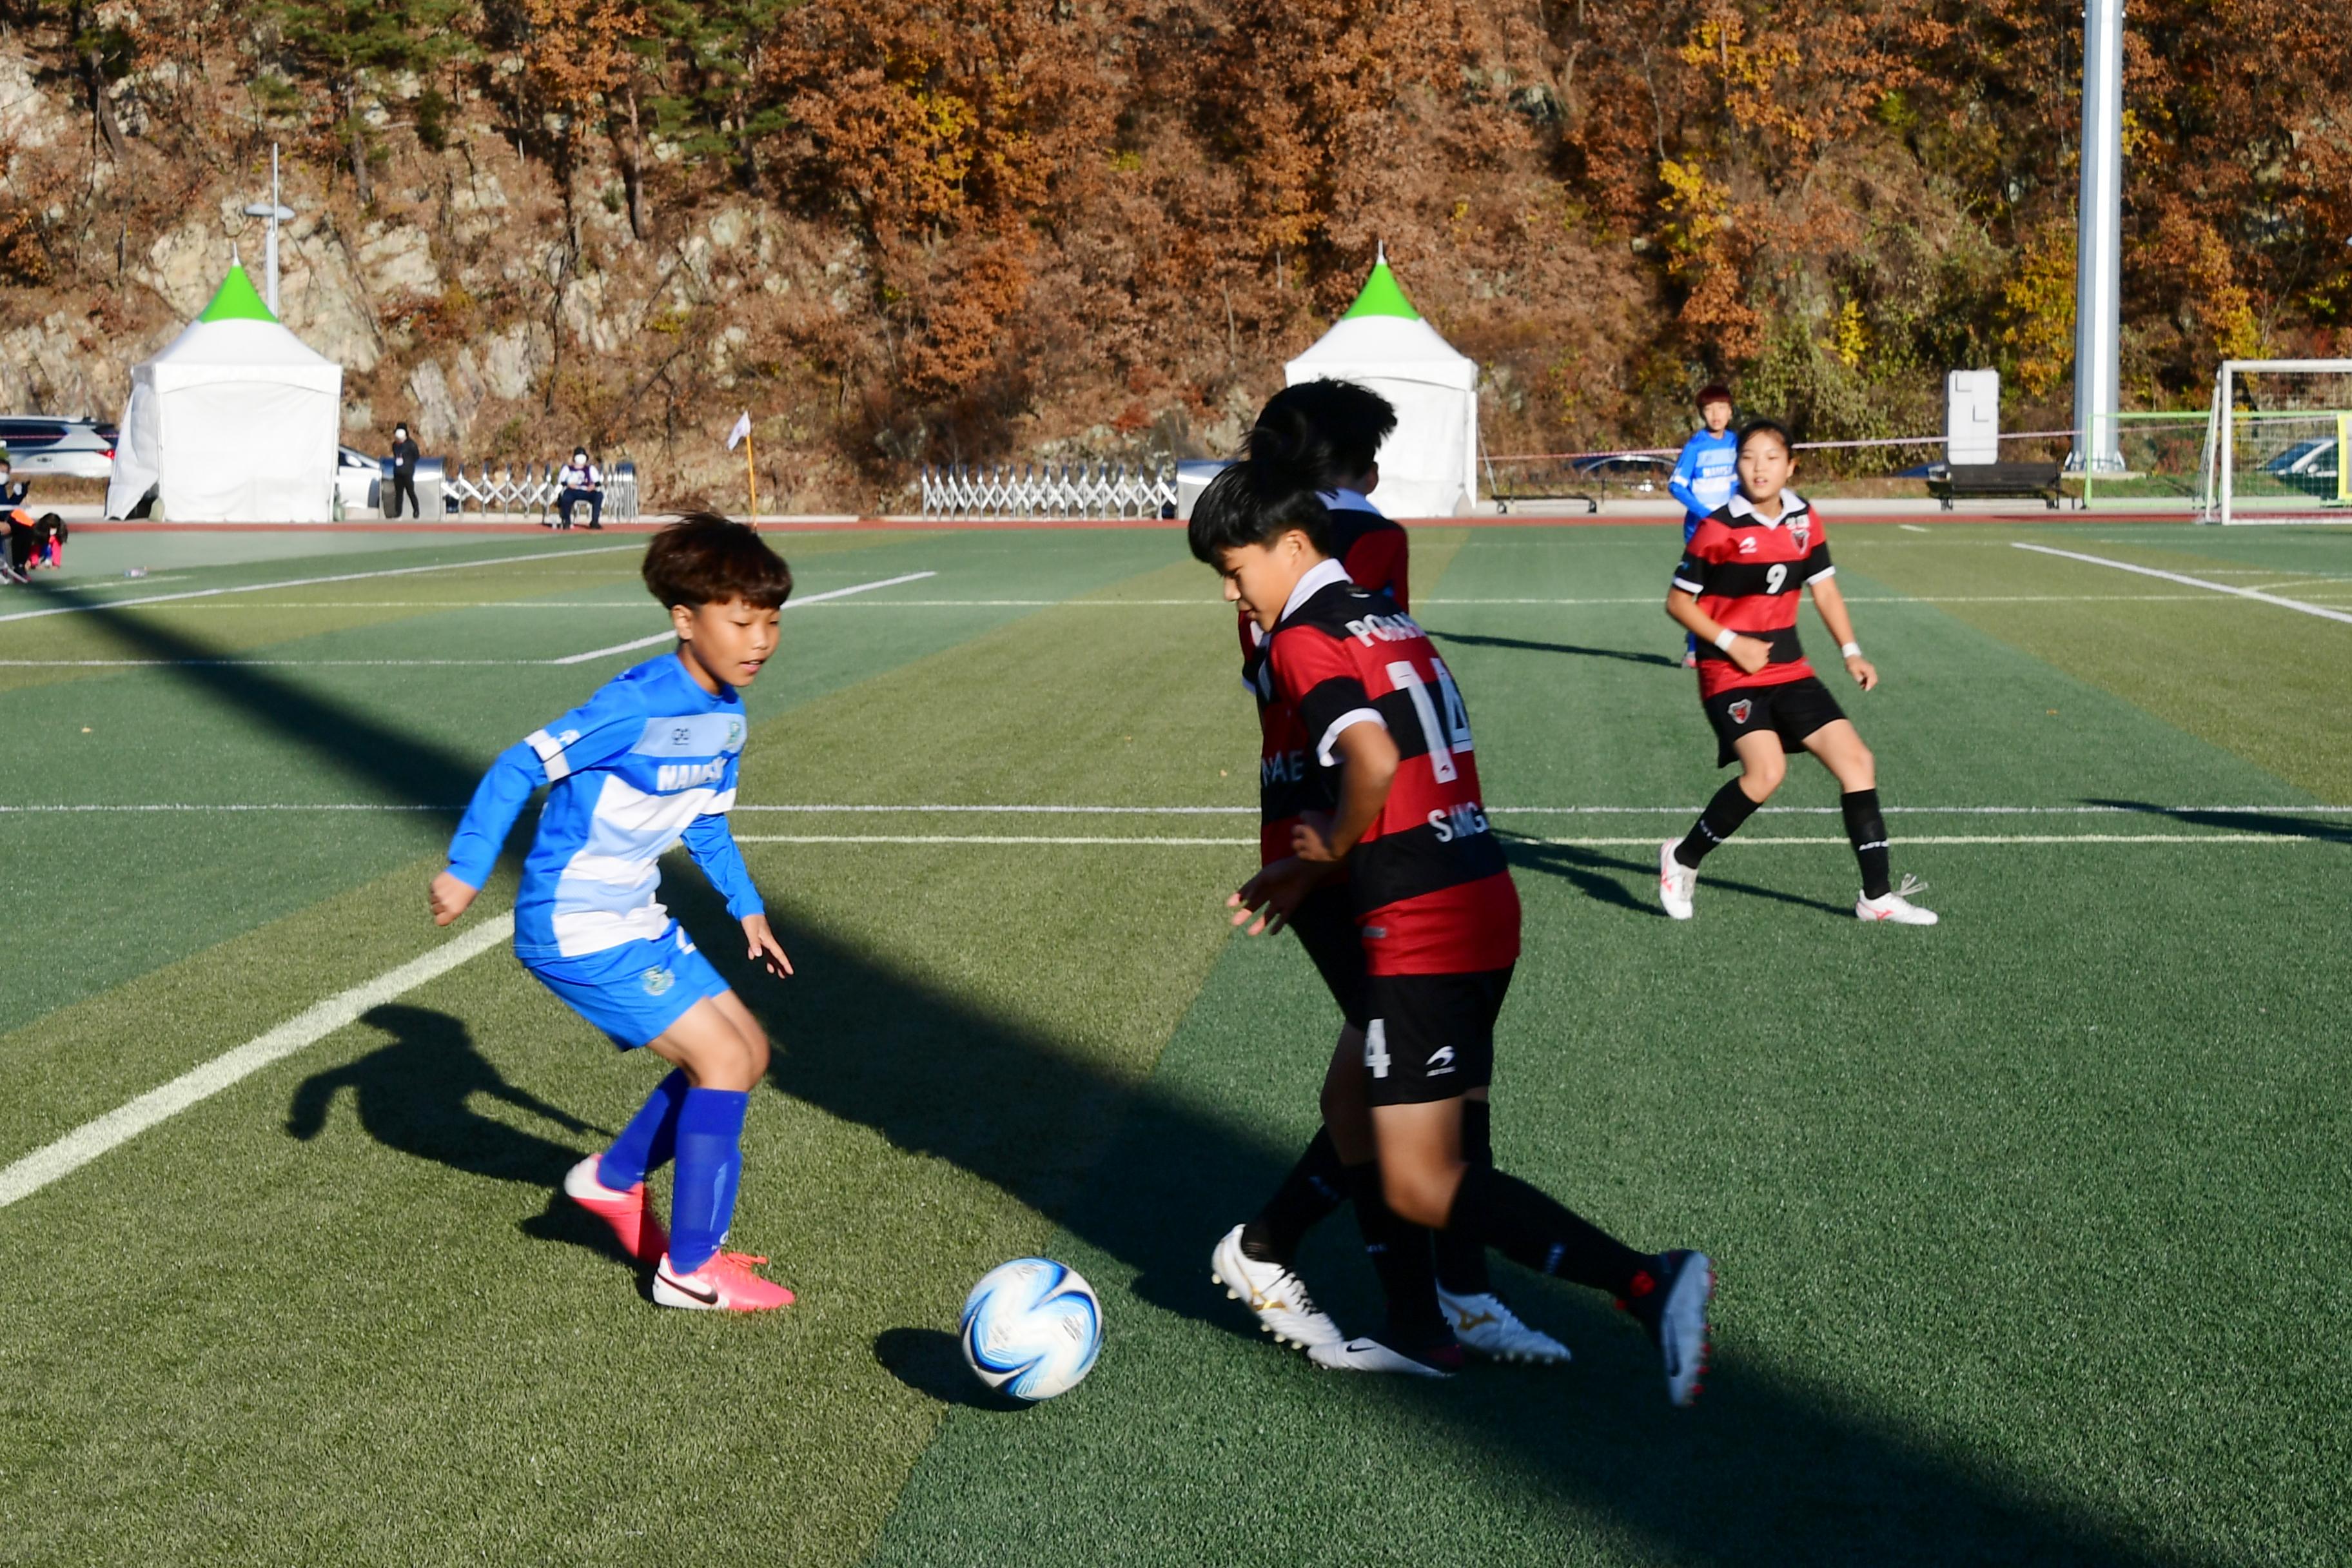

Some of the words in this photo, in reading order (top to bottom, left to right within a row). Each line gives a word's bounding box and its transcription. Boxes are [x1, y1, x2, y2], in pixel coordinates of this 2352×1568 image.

[1766, 564, 1787, 594] 9
[1385, 658, 1474, 784] 14
[1364, 1018, 1391, 1079] 4
